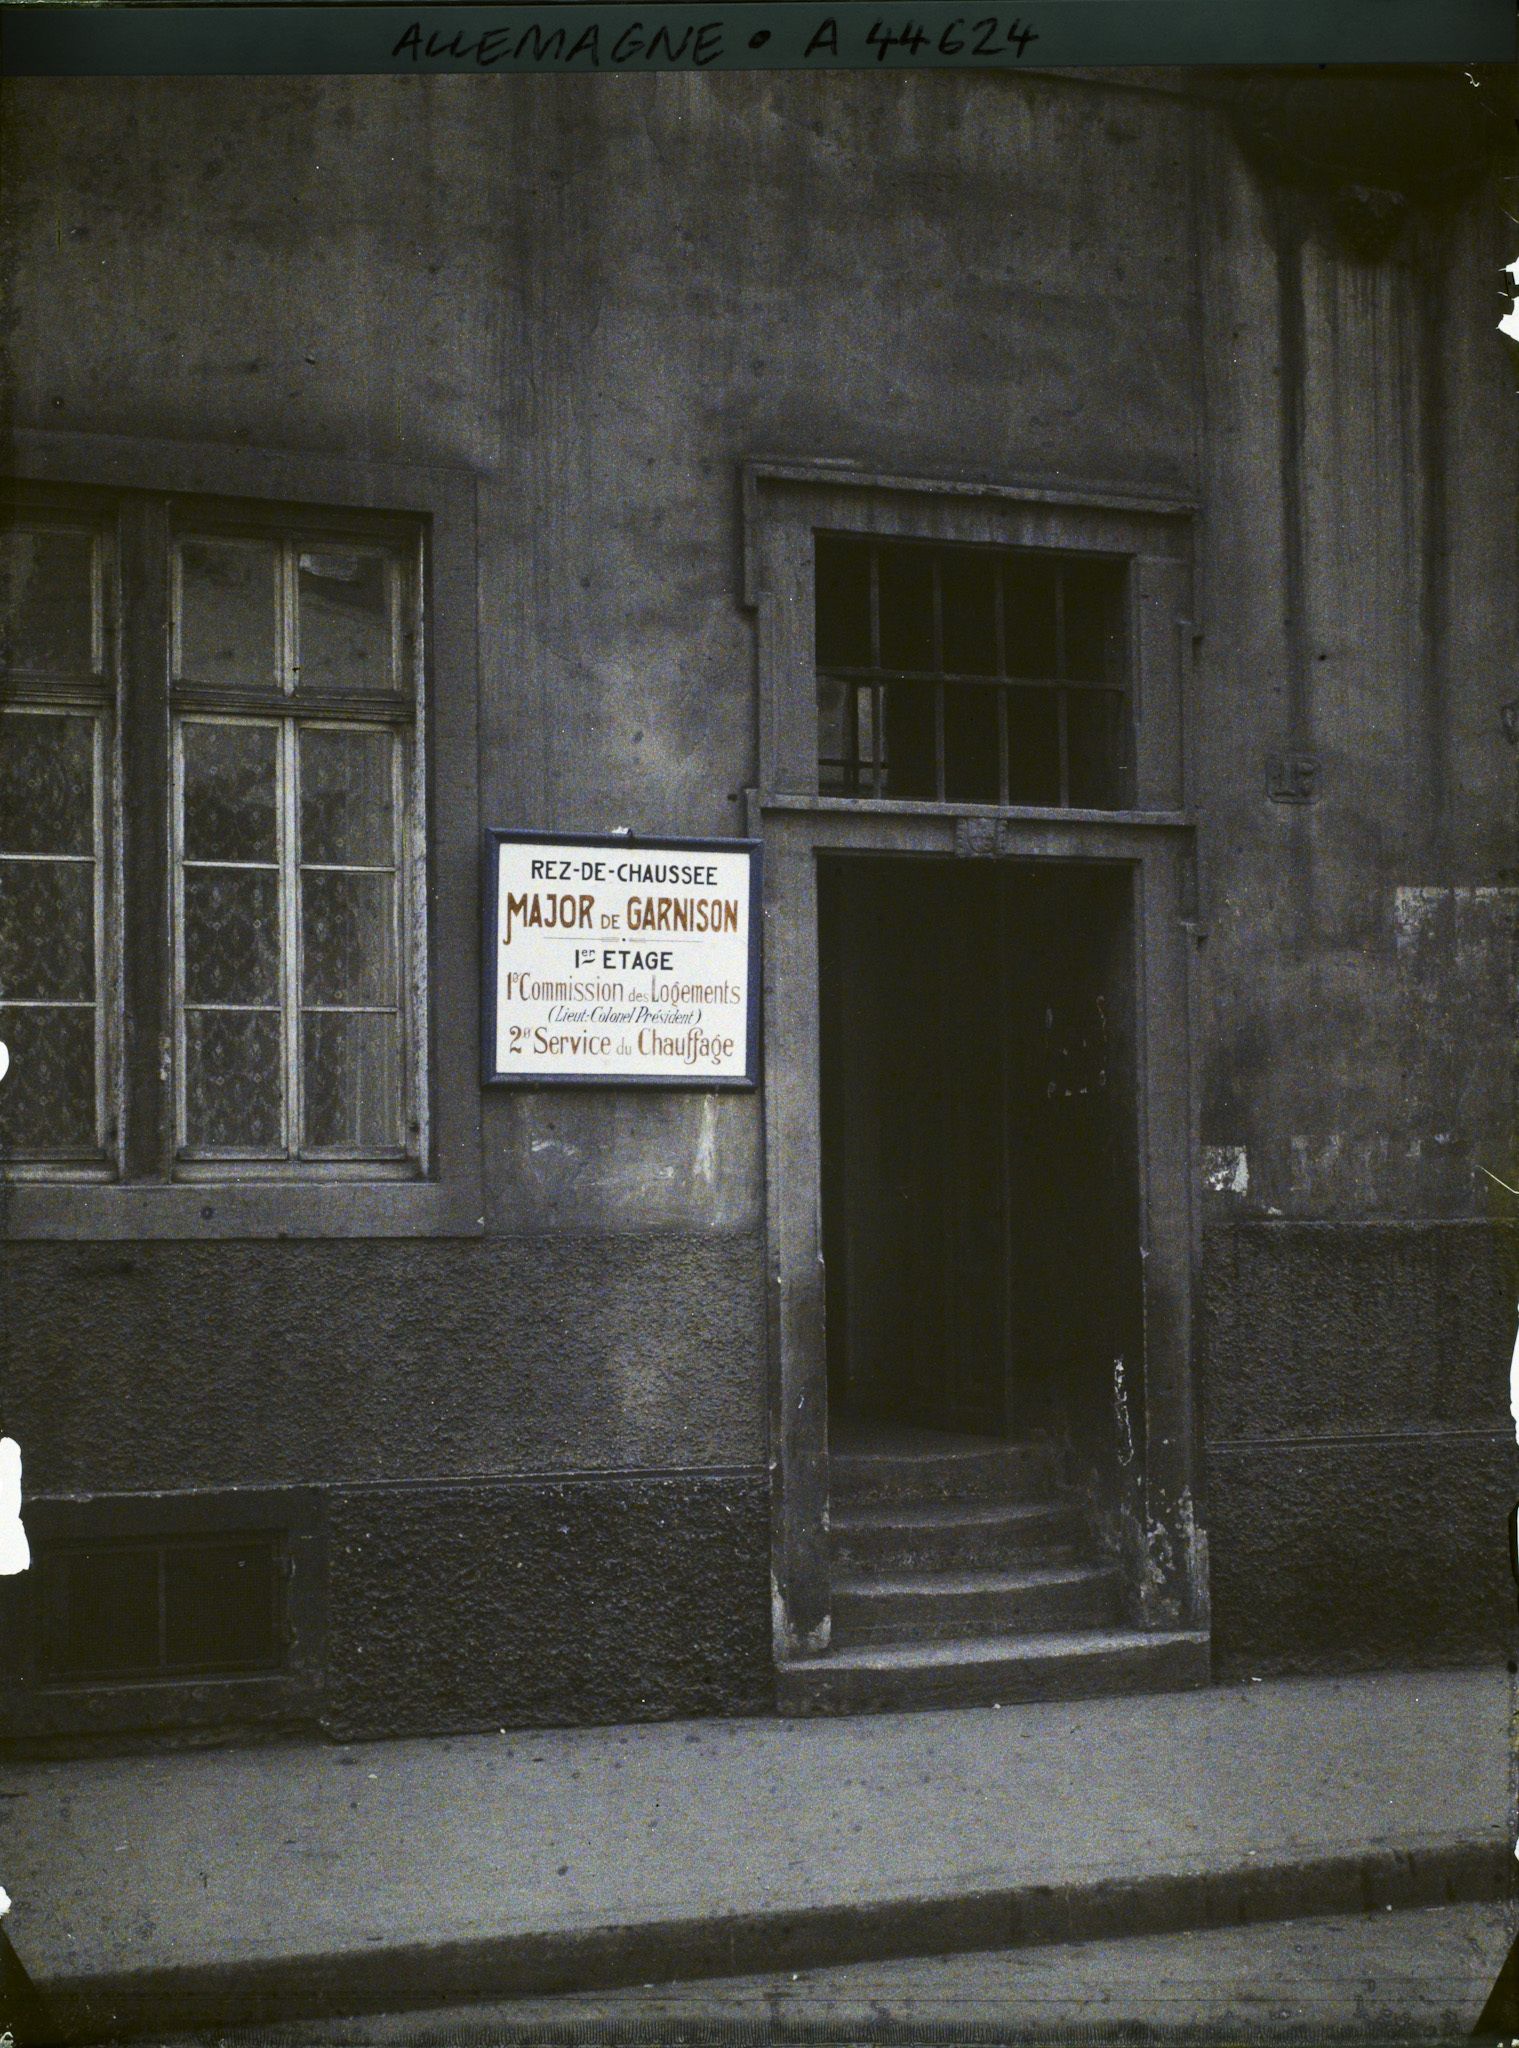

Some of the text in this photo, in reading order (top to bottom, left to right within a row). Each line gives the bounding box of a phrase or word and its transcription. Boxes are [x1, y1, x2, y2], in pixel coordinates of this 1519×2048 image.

[391, 18, 1041, 67] ALLEMAGNE A 44624
[531, 860, 718, 886] REZ-DE-CHAUSSEE
[503, 892, 739, 946] MAJOR DE GARNISON
[603, 951, 674, 970] ETAGE
[519, 972, 625, 1002] Commission
[628, 987, 650, 1002] des
[651, 974, 741, 1008] Logements
[533, 1026, 612, 1055] Service
[616, 1036, 632, 1056] du
[637, 1027, 734, 1066] Chauffage
